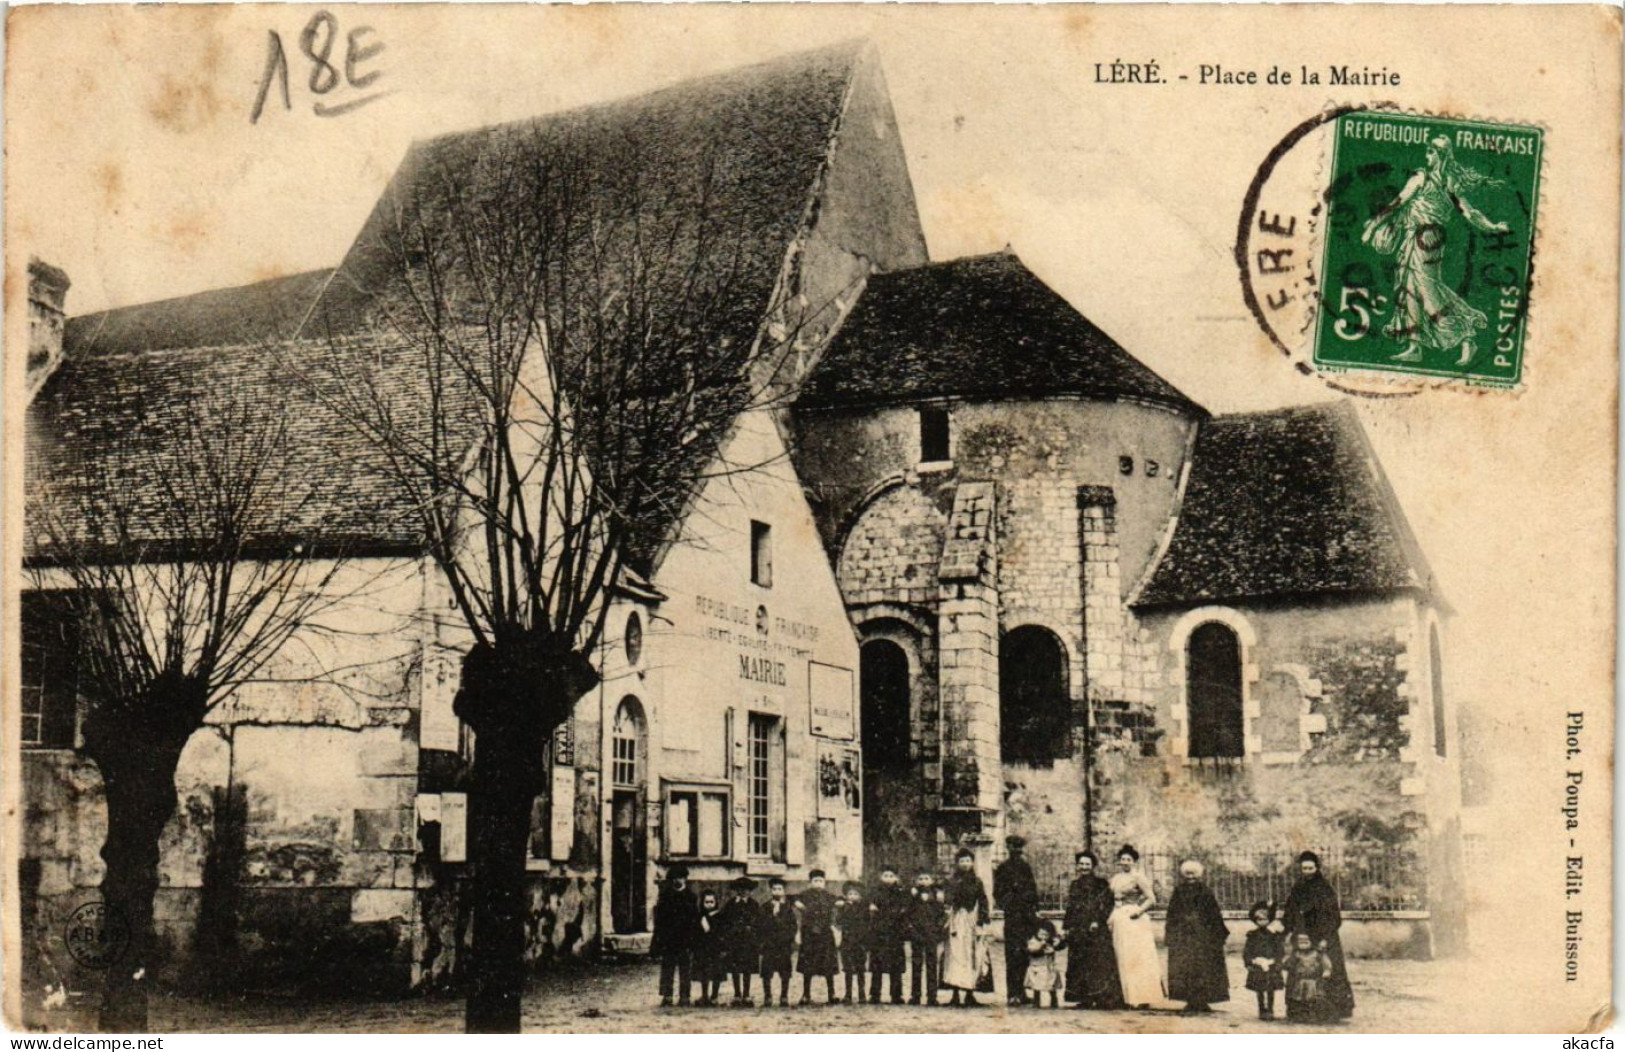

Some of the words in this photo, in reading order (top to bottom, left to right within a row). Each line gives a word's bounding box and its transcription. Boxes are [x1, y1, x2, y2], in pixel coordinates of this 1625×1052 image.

[1094, 58, 1167, 84] LÉRÉ.
[1199, 65, 1257, 85] Place
[1266, 65, 1292, 85] de
[1300, 65, 1320, 85] la
[1328, 65, 1401, 85] Mairie
[1456, 130, 1534, 156] FRANÇAISE
[1494, 285, 1521, 367] POSTES
[739, 654, 787, 687] MAIRIE
[1566, 711, 1583, 761] Phot.
[1562, 771, 1583, 831] Poupa
[1566, 857, 1583, 901] Edit.
[1566, 911, 1582, 982] Buisson
